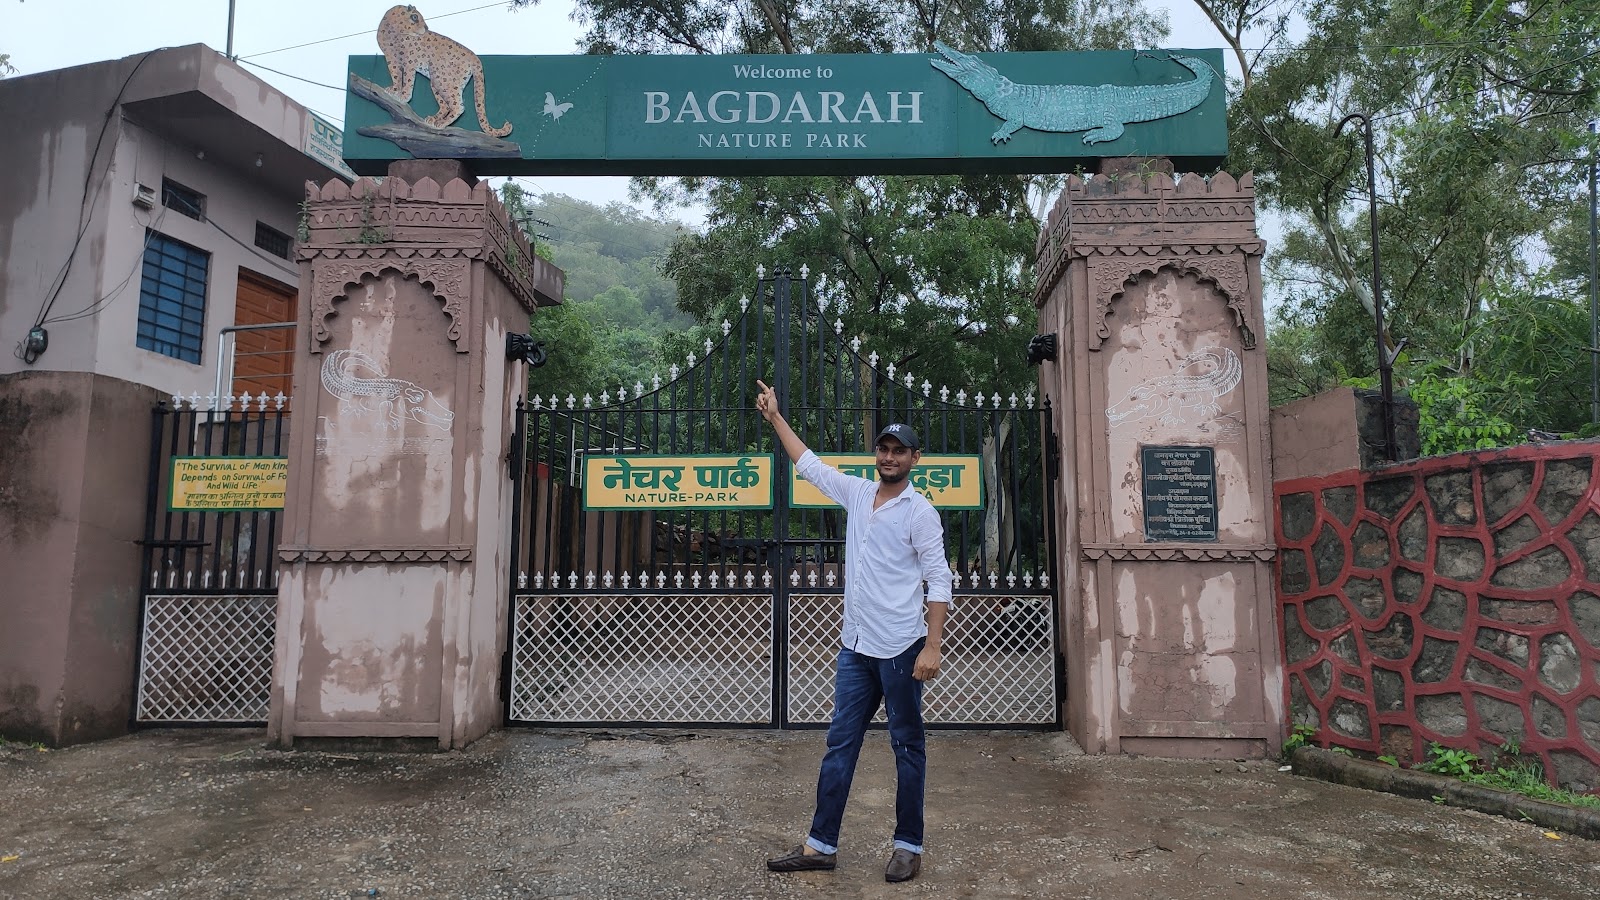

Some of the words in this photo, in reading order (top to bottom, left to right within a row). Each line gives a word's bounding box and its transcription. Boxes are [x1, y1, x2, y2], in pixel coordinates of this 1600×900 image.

[733, 64, 812, 79] Welcome
[817, 65, 833, 79] to
[643, 90, 924, 124] BAGDARAH
[698, 133, 792, 148] NATURE
[806, 133, 868, 148] PARK
[181, 473, 217, 483] Depends
[278, 472, 287, 480] Fo
[603, 459, 685, 492] नेचर
[693, 457, 760, 489] पार्क
[625, 492, 739, 503] NATURE-PARK
